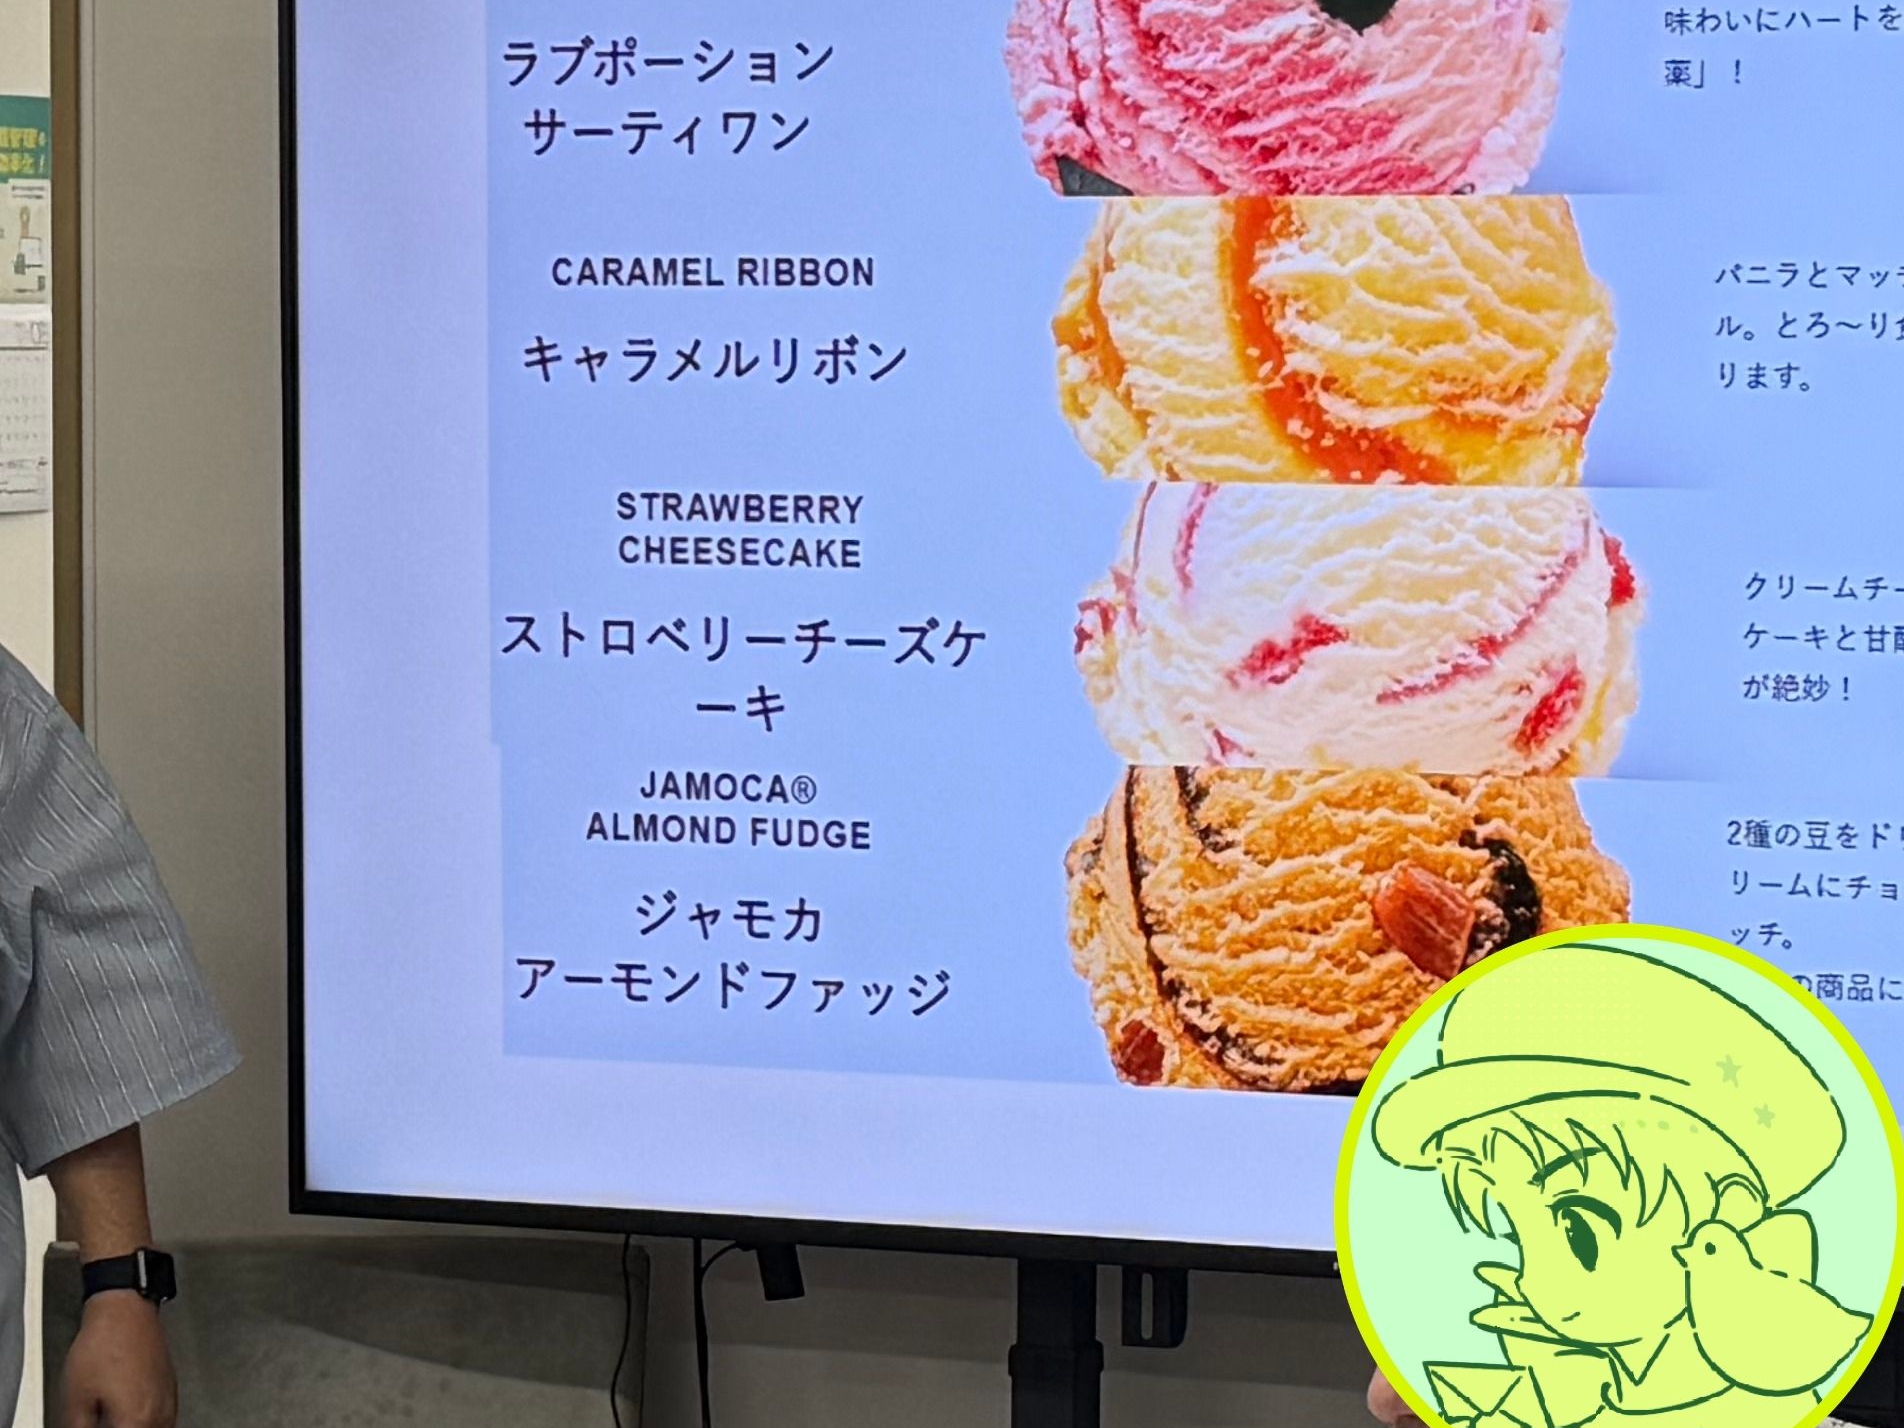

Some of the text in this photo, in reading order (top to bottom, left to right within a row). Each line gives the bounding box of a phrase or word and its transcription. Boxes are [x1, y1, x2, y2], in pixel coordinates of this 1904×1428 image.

[501, 33, 835, 88] ラブポーション
[522, 106, 811, 158] サーティワン
[550, 255, 875, 288] CARAMEL RIBBON
[522, 332, 908, 386] キャラメルリボン
[1718, 360, 1812, 393] ります。
[615, 491, 865, 526] STRAWBERRY
[617, 533, 863, 569] CHEESECAKE
[500, 610, 988, 669] ストロベリーチーズケ
[695, 684, 787, 734] ーキ
[1741, 672, 1851, 704] が絶妙！
[584, 810, 872, 851] ALMOND FUDGE
[634, 888, 822, 944] ジャモカ
[1730, 921, 1794, 952] ッチ。
[514, 956, 952, 1018] アーモンドファッジ
